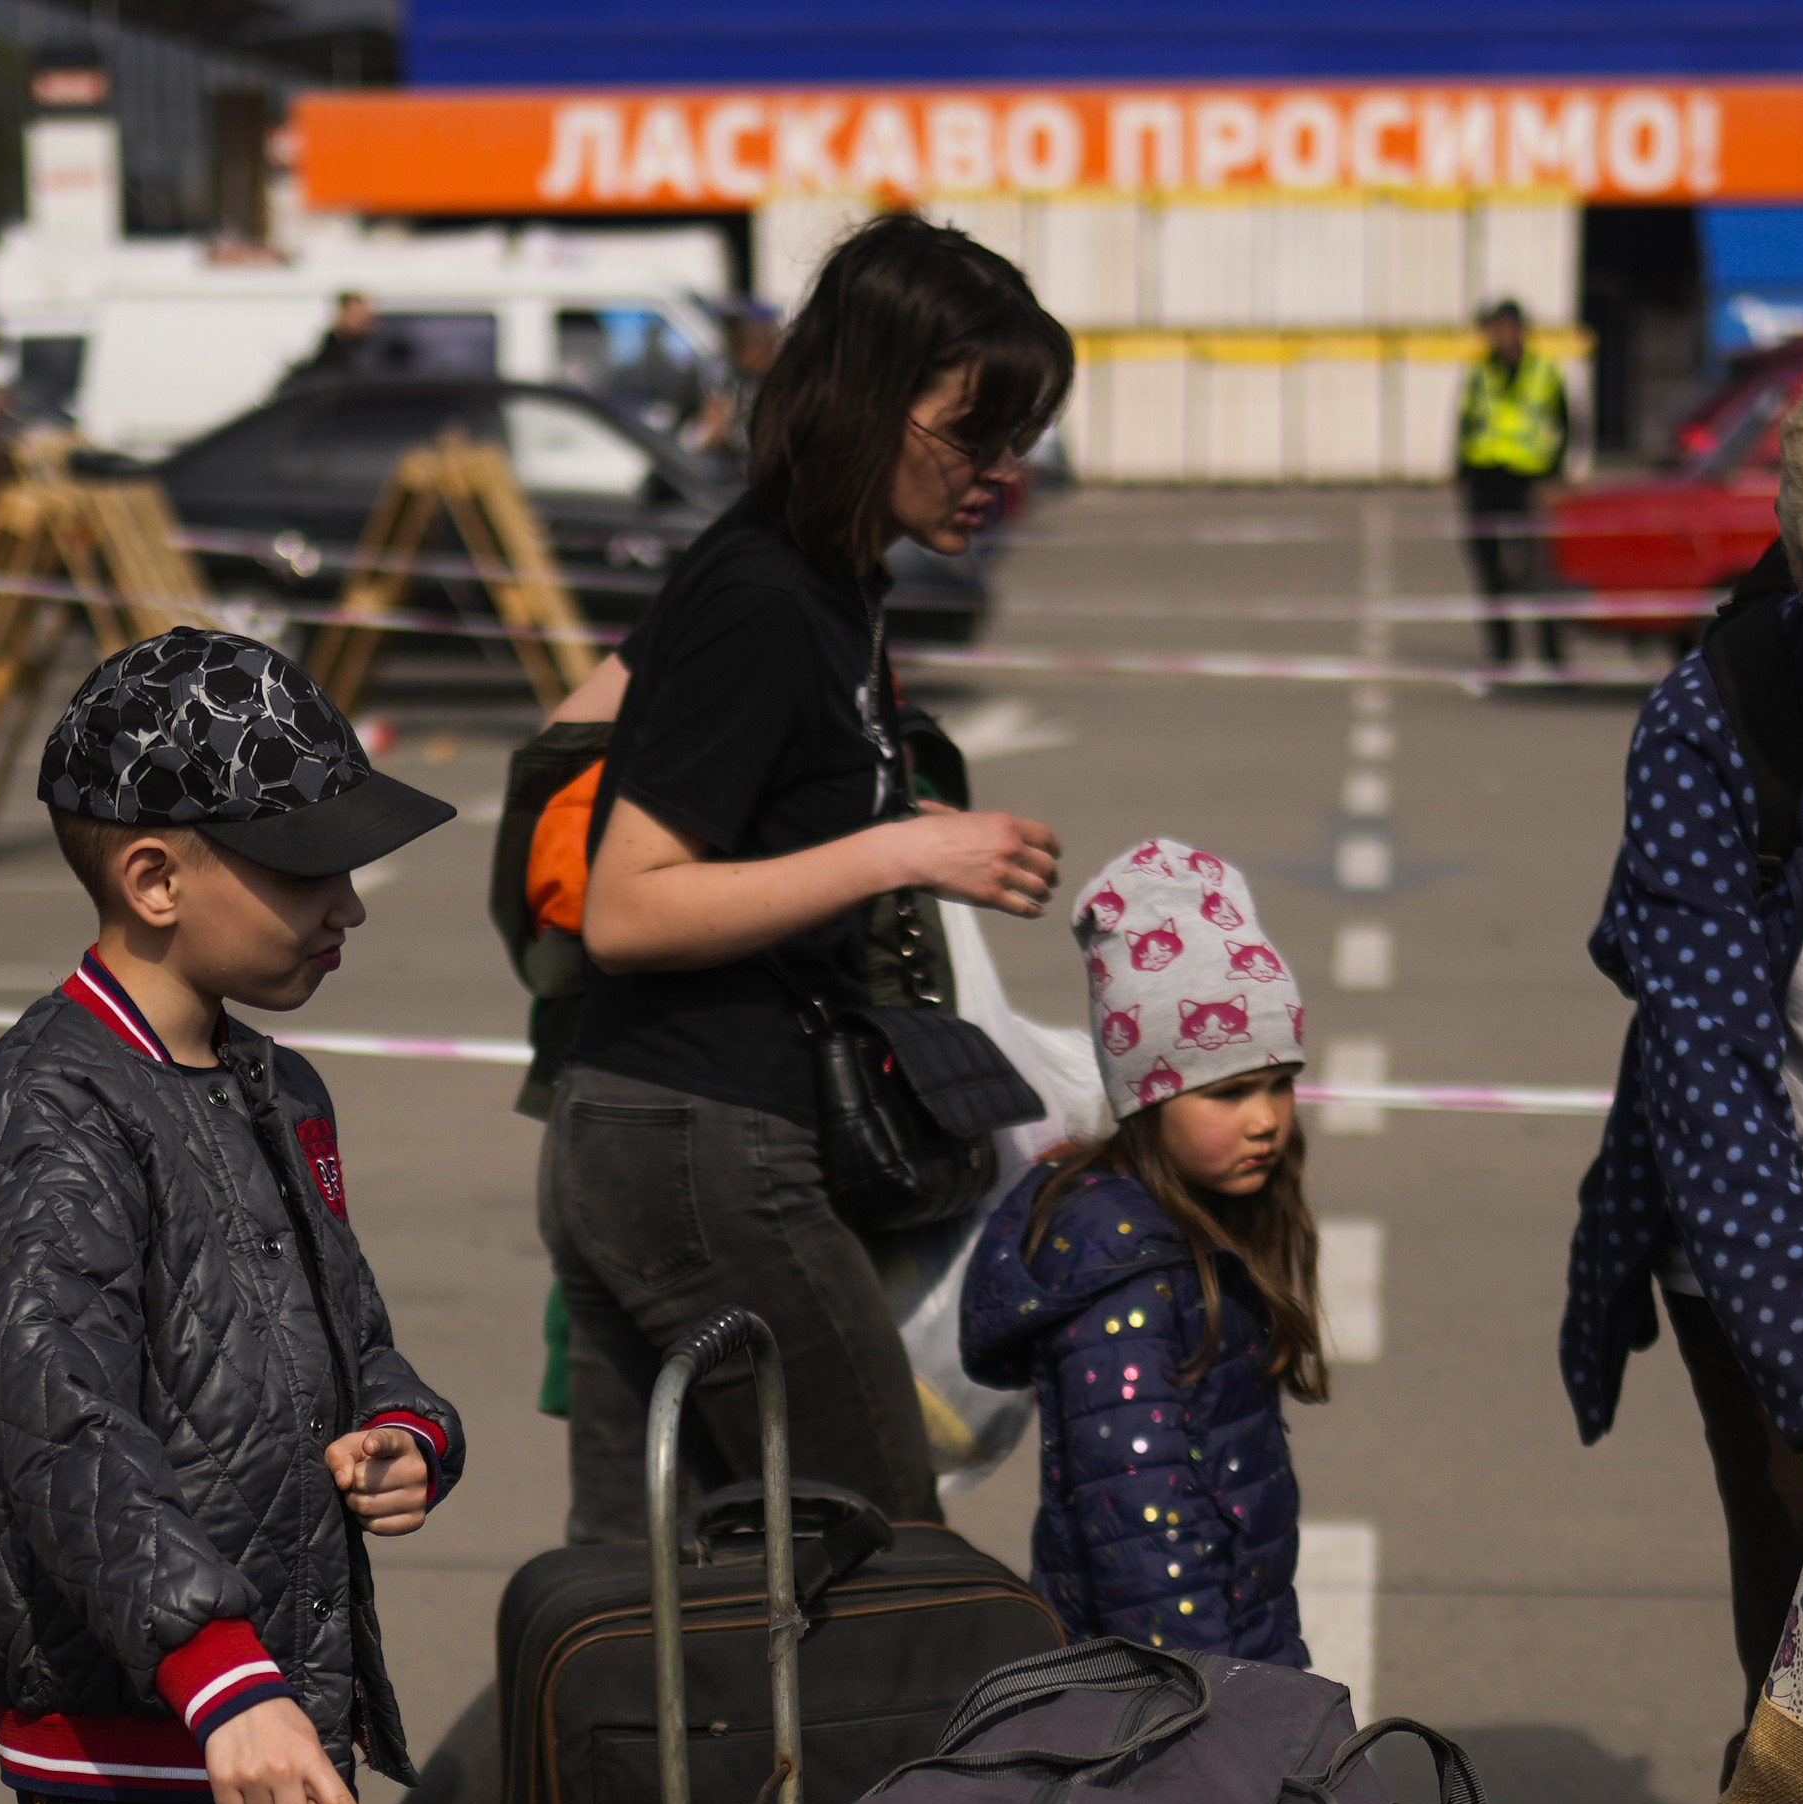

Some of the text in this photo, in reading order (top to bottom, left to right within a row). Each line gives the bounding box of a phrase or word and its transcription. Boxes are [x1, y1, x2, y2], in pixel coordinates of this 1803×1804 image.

[538, 94, 1726, 201] ЛАСКАВО ПРОСИМО!
[316, 1157, 341, 1200] 95
